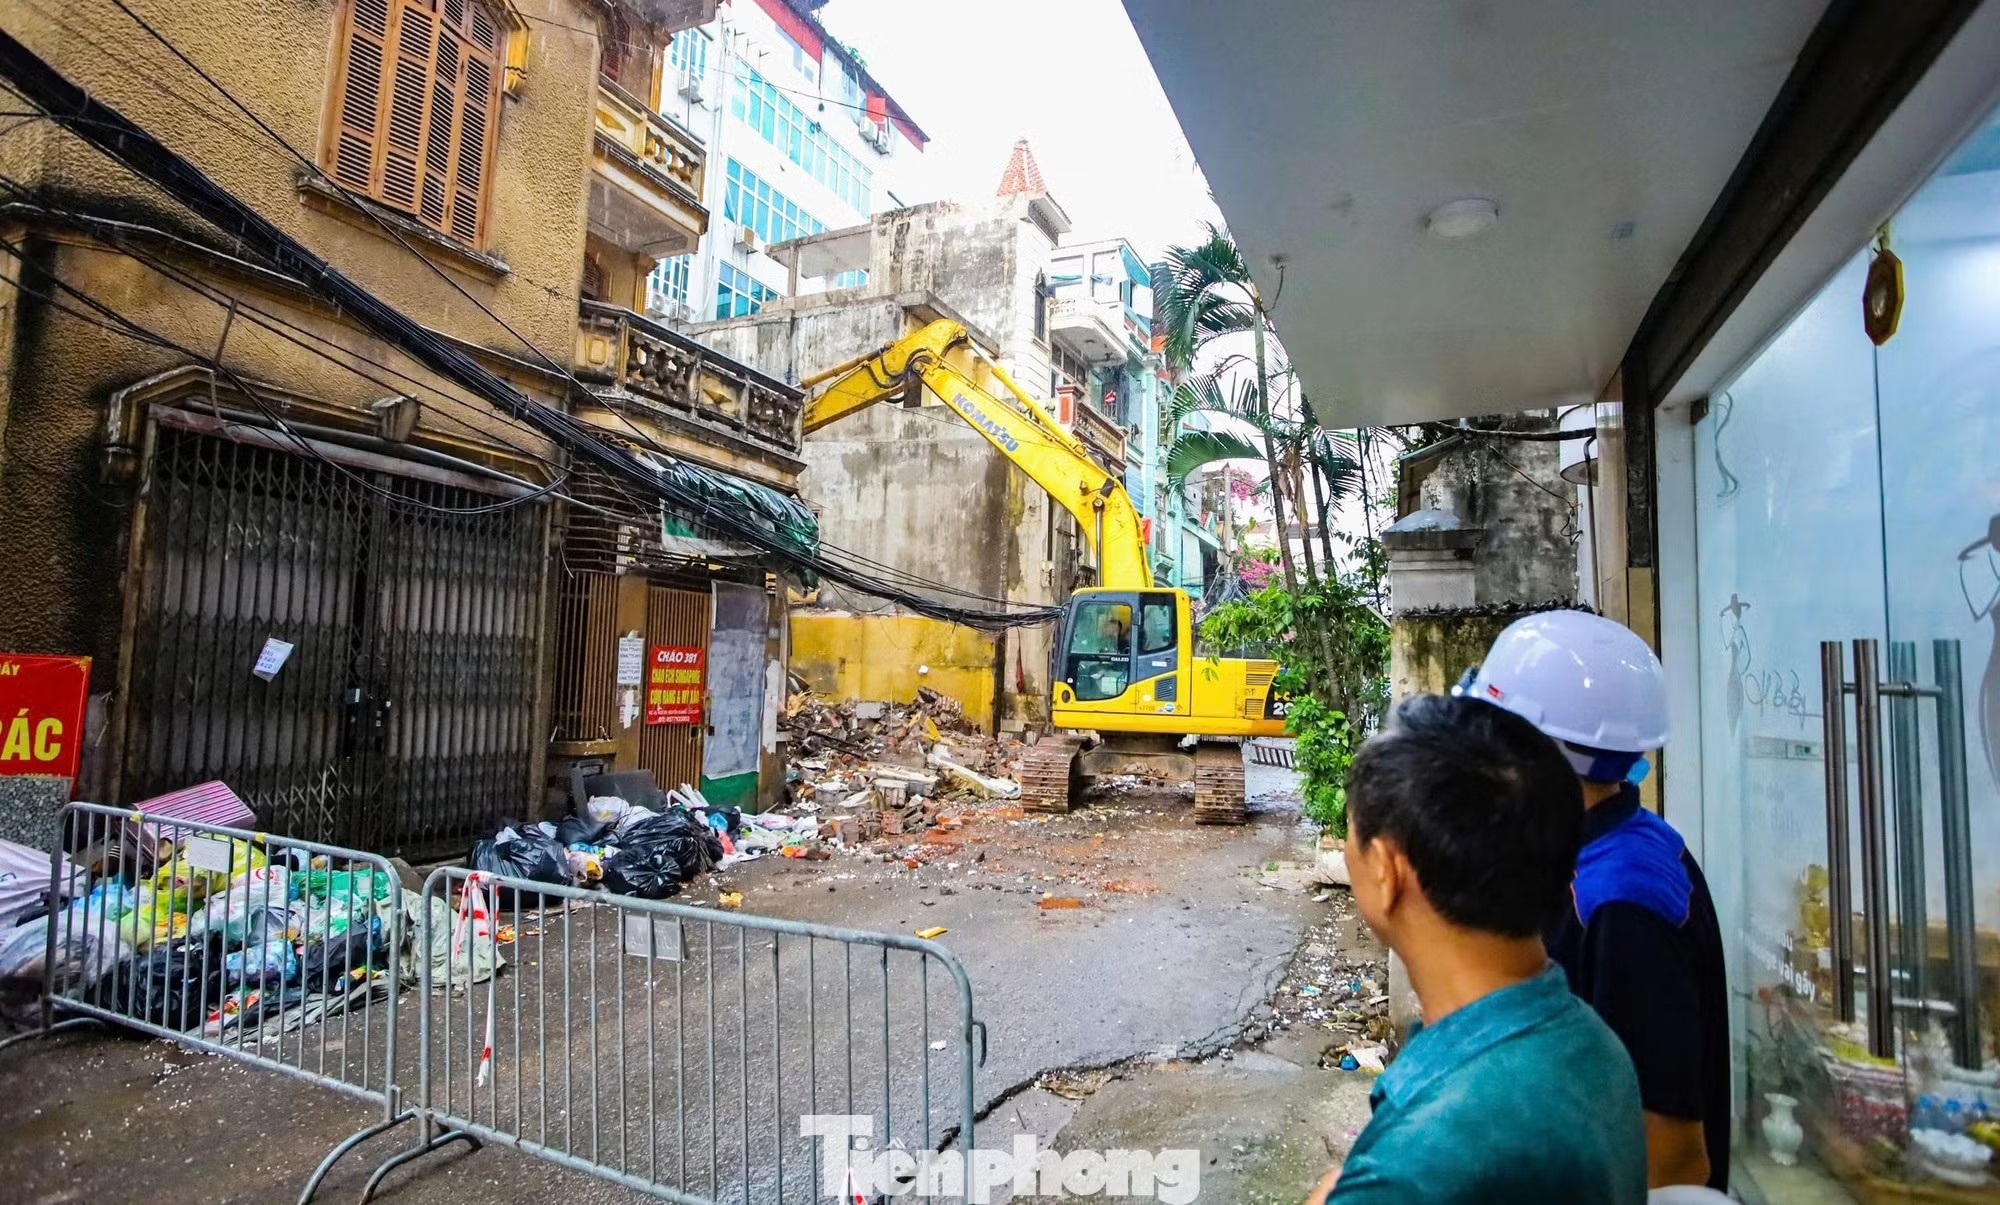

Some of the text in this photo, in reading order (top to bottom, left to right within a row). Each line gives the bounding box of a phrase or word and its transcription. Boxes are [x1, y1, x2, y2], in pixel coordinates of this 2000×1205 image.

[952, 393, 1019, 452] KOMATSU
[684, 652, 698, 664] 381
[0, 708, 63, 762] ÁC
